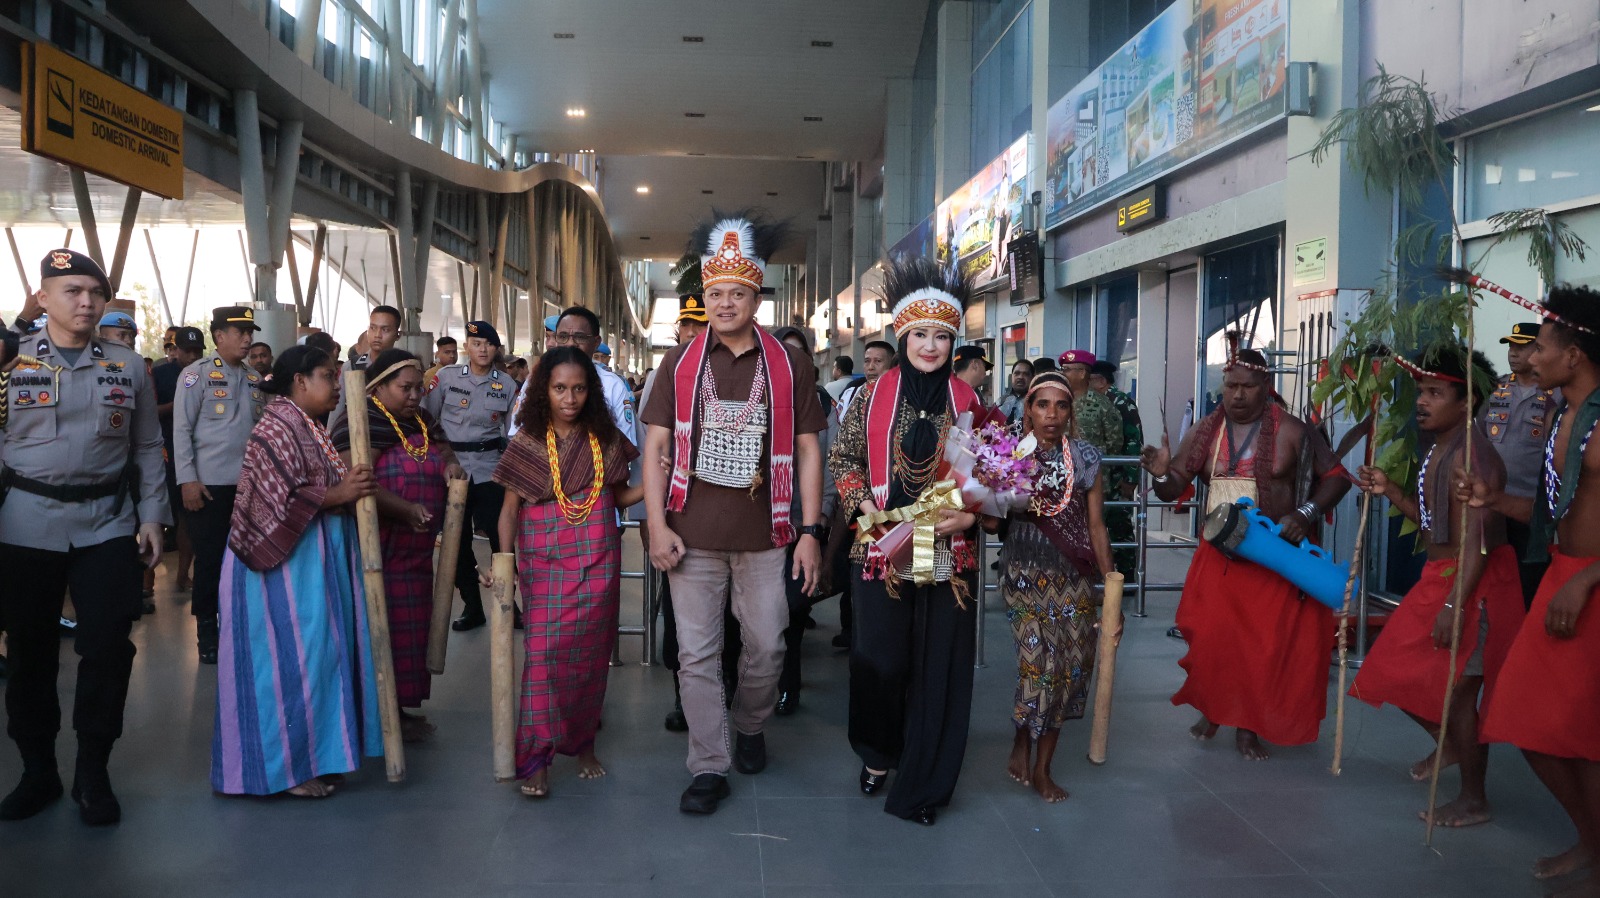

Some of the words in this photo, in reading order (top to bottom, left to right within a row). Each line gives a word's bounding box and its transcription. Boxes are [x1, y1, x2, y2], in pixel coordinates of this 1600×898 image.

[79, 87, 140, 127] KEDATANGAN
[141, 117, 180, 147] DOMESTIK
[92, 121, 136, 152] DOMESTIC
[137, 145, 171, 167] ARRIVAL
[97, 376, 132, 387] POLRI
[487, 391, 507, 399] POLRI
